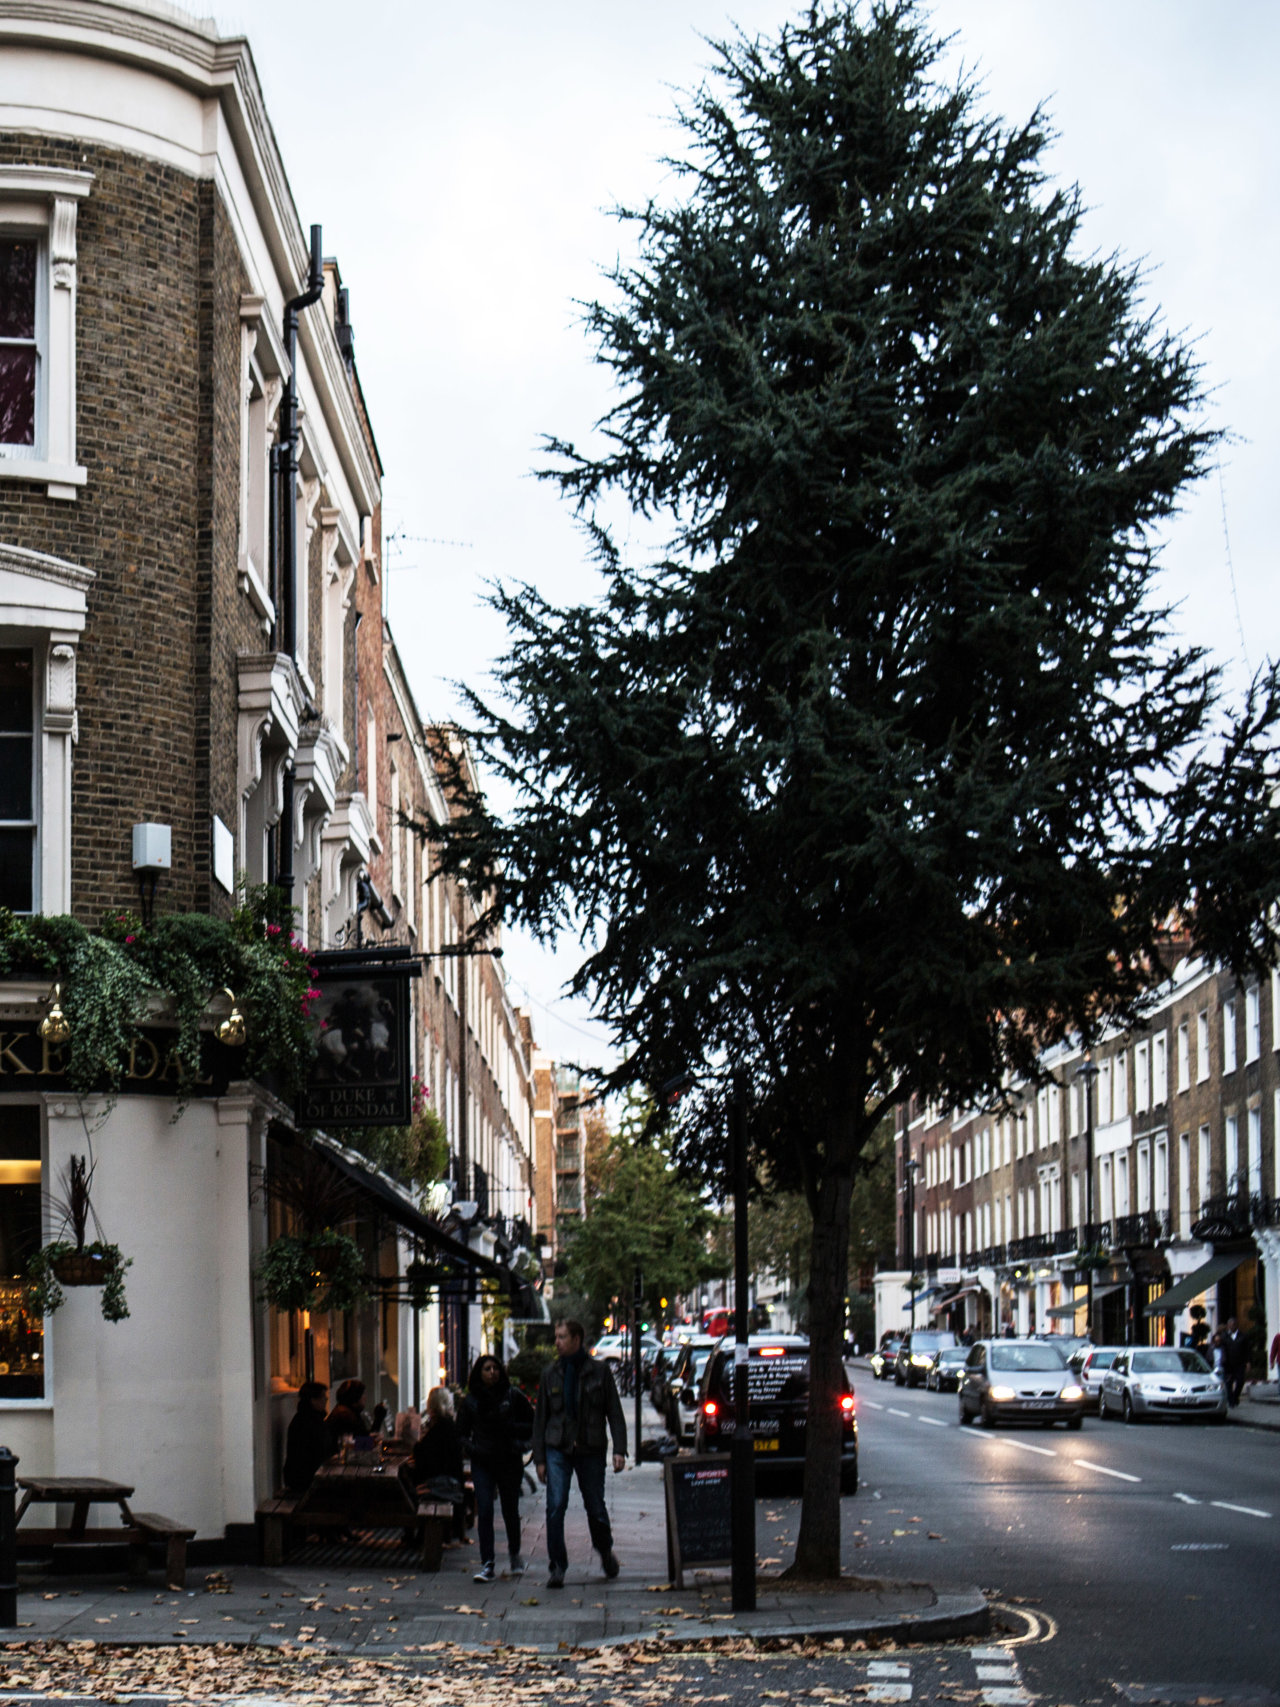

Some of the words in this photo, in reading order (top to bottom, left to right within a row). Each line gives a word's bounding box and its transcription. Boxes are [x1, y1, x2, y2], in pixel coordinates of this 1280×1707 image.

[330, 1088, 376, 1103] DUKE
[307, 1104, 328, 1118] OF
[333, 1103, 400, 1118] KENDAL
[782, 1358, 807, 1366] Laundry
[684, 1472, 696, 1480] sky
[696, 1470, 728, 1478] SPORTS
[691, 1479, 704, 1487] LIVE
